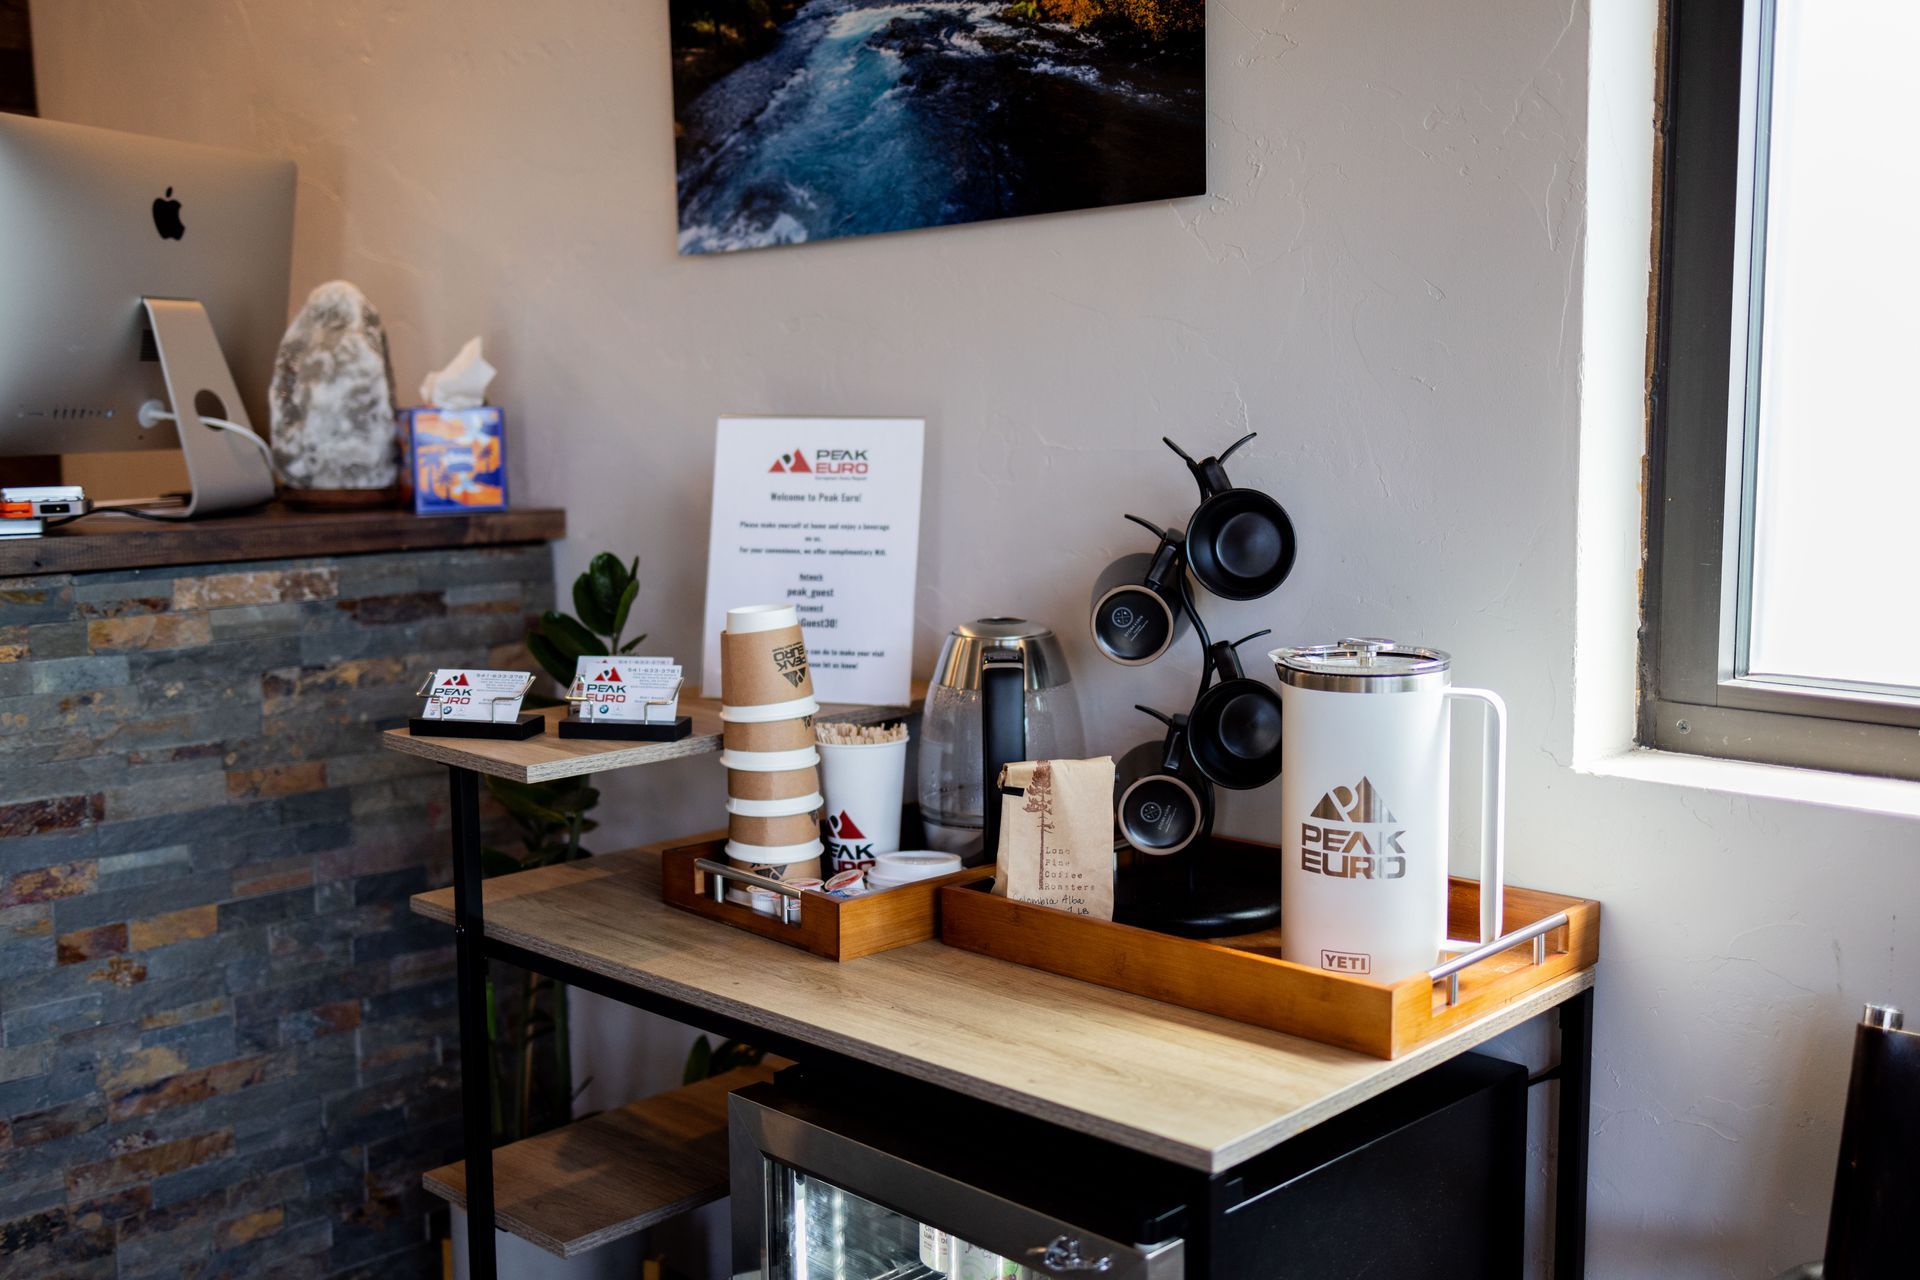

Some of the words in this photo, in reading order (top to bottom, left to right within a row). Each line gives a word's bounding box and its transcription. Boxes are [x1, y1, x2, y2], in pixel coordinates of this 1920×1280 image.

[816, 449, 868, 461] PEAK
[816, 462, 868, 474] EURO
[770, 492, 805, 502] Welcome
[808, 493, 816, 502] to
[819, 492, 838, 502] Peak
[740, 521, 759, 529] Please
[778, 522, 801, 531] yourself
[828, 548, 873, 557] complimentary
[799, 573, 823, 582] Network
[786, 588, 834, 599] peak_guest
[773, 645, 805, 662] EURO
[776, 655, 807, 672] PEAK
[433, 688, 473, 697] PEAK
[587, 684, 627, 693] PEAK
[585, 693, 626, 703] EURO
[1301, 822, 1408, 855] PEAK
[830, 842, 876, 860] EAK
[1301, 847, 1406, 880] EURO
[1044, 870, 1083, 879] Coffee
[1044, 882, 1096, 891] Roasters
[1061, 893, 1085, 905] Alba
[1325, 953, 1366, 971] YETI
